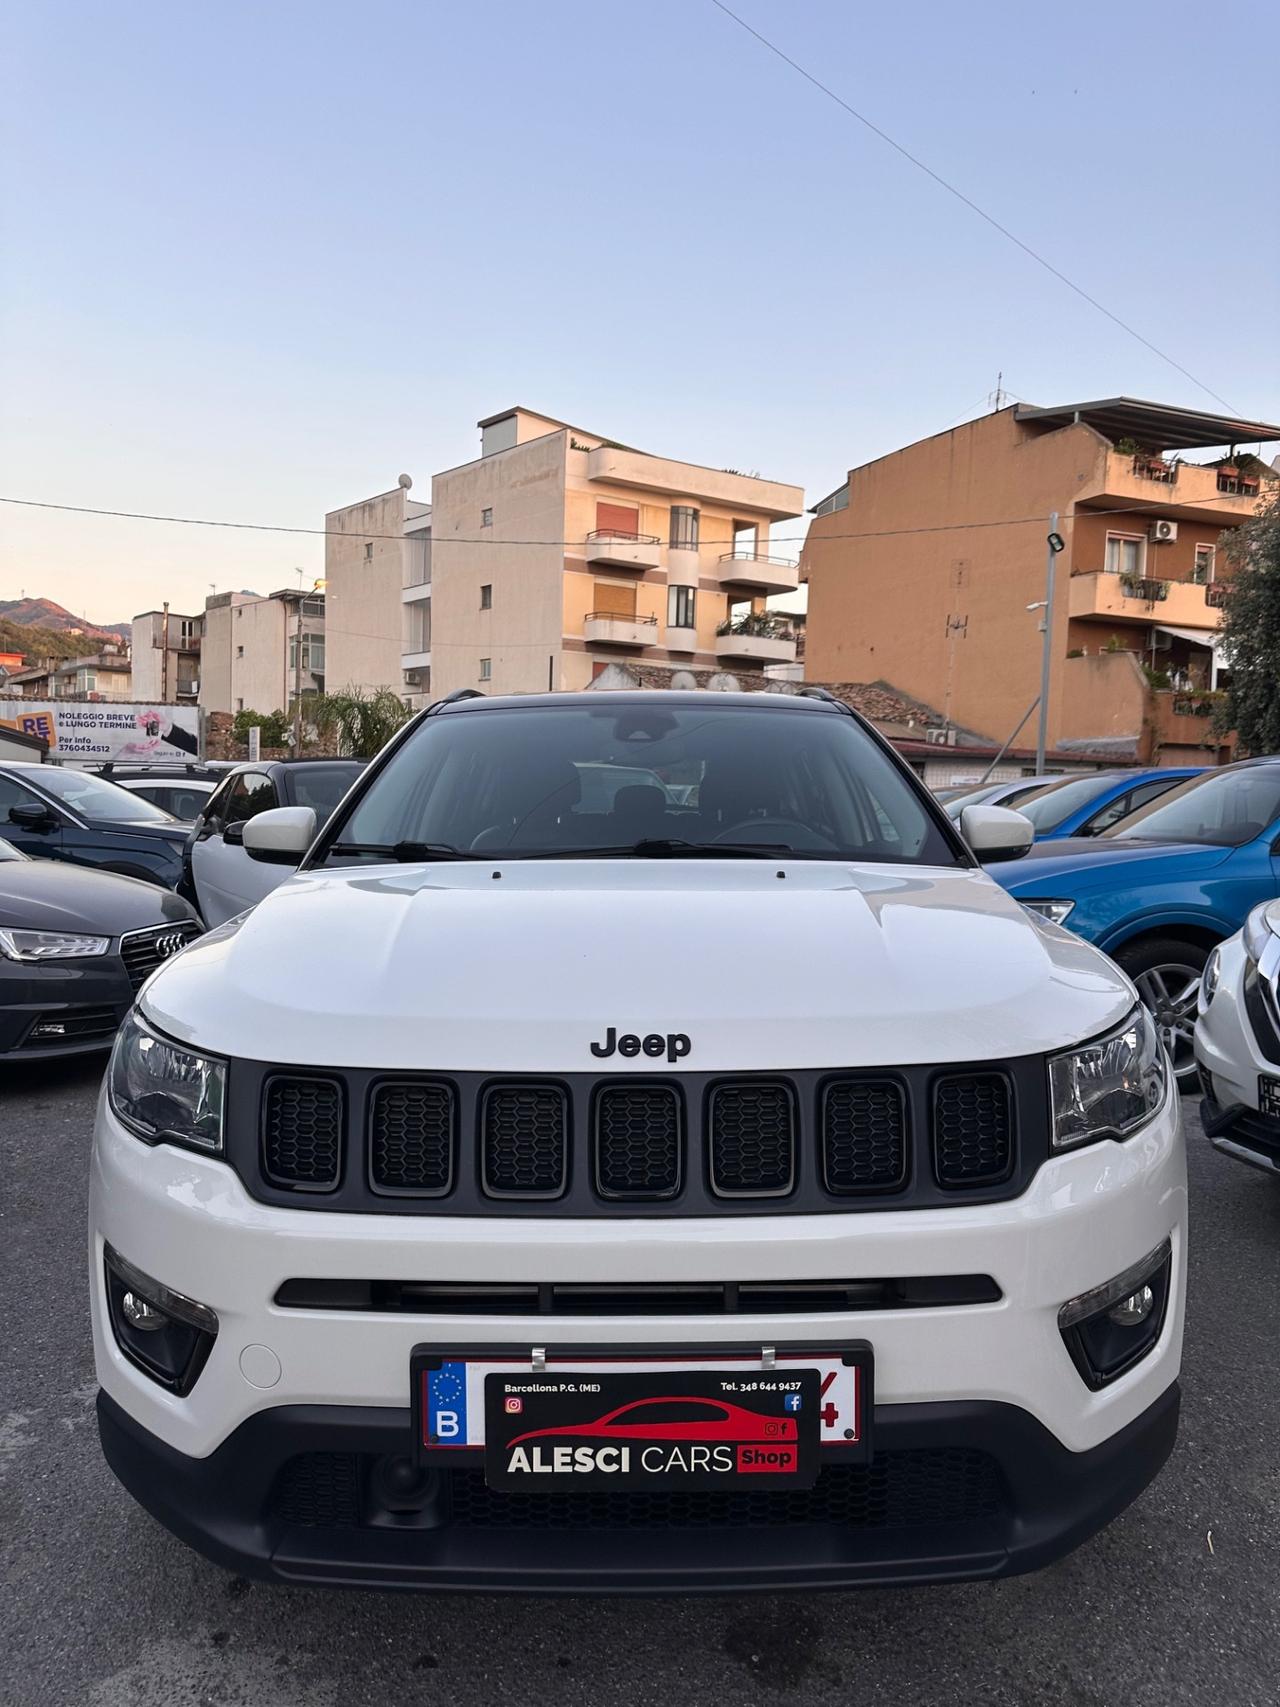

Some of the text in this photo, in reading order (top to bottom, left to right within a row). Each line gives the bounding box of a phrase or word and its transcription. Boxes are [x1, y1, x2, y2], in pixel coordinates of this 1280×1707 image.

[59, 712, 104, 720] NOLEGGIO
[590, 1027, 691, 1063] Jeep
[504, 1384, 601, 1393] Barcellona P.G. (ME)
[721, 1381, 801, 1391] Tel. 348 644 9437
[436, 1411, 460, 1437] B
[507, 1446, 792, 1473] ALESCI CARS Shop
